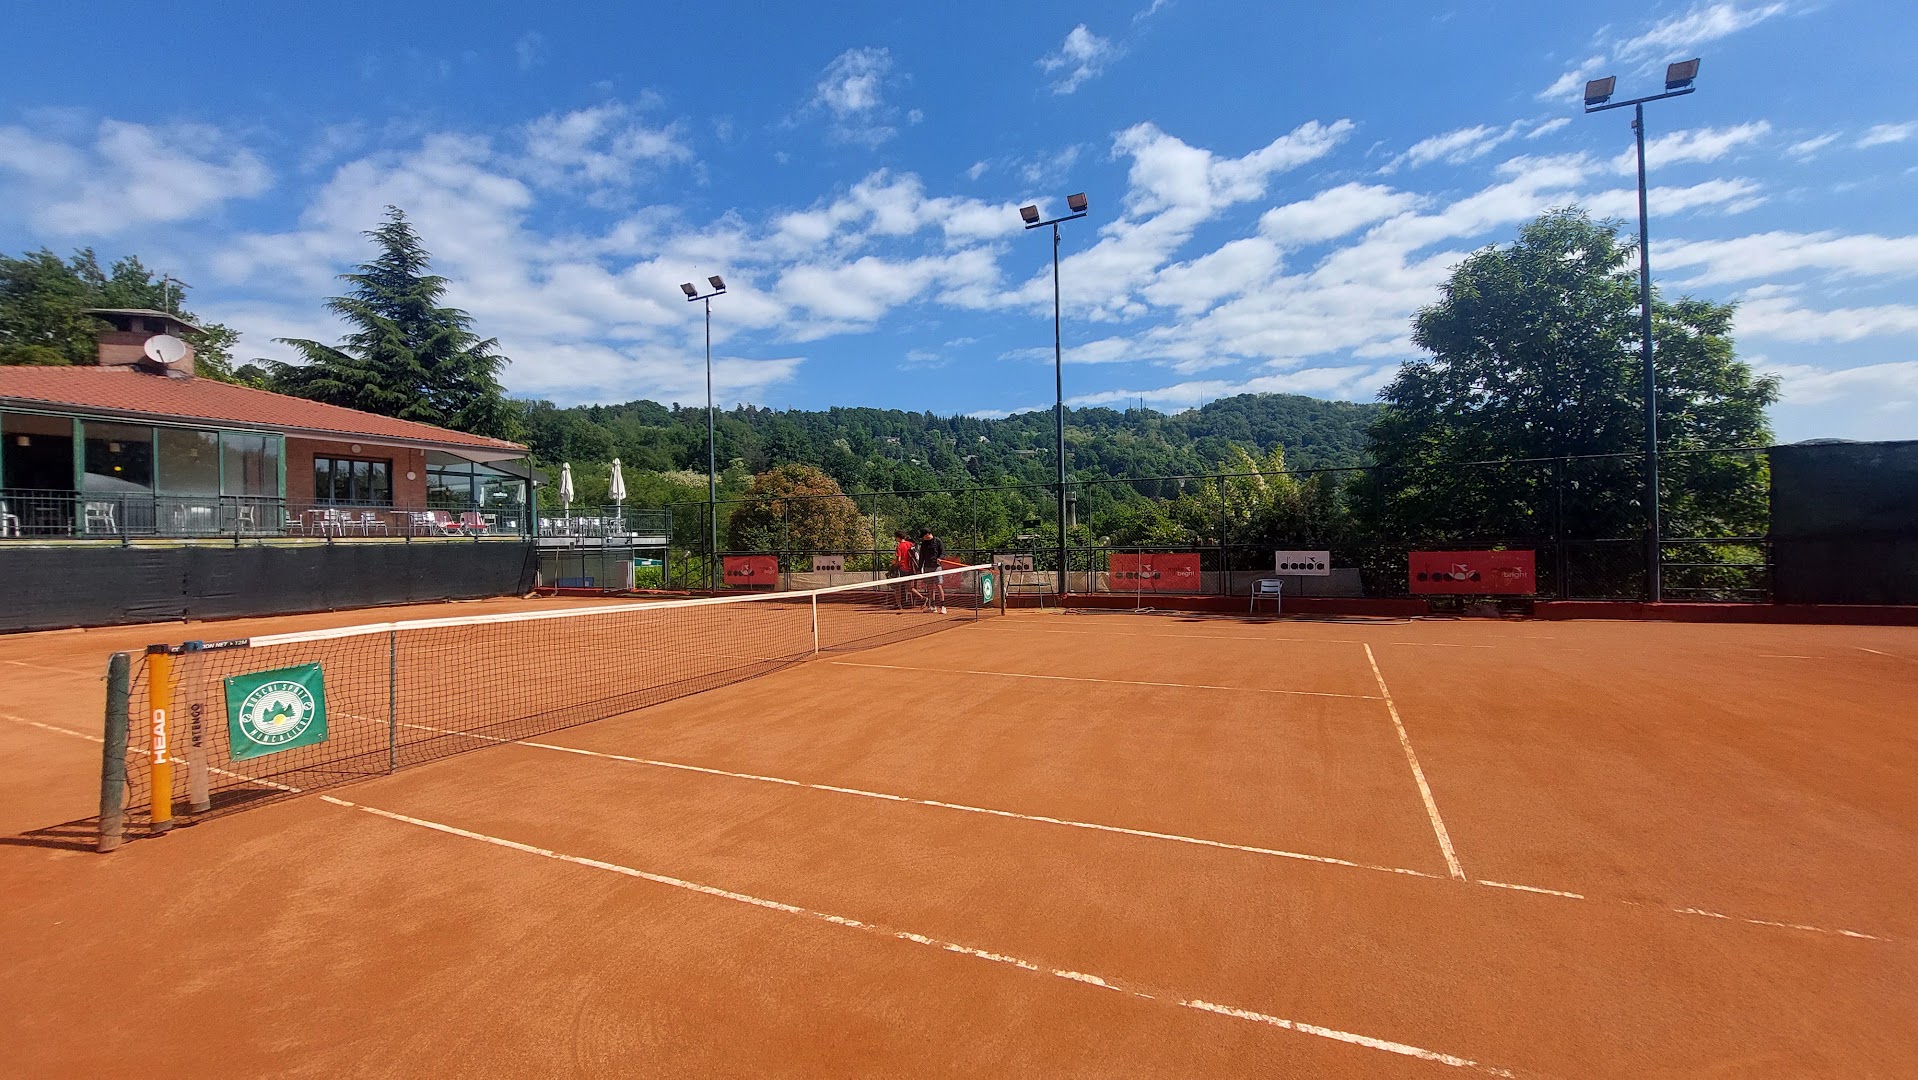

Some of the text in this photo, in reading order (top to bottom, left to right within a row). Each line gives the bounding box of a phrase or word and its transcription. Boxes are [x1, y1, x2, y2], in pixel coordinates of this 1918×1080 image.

[1280, 556, 1325, 571] diadora
[153, 708, 167, 765] HEAD
[190, 703, 203, 748] ARTENGO
[250, 717, 309, 742] MONCALIERI
